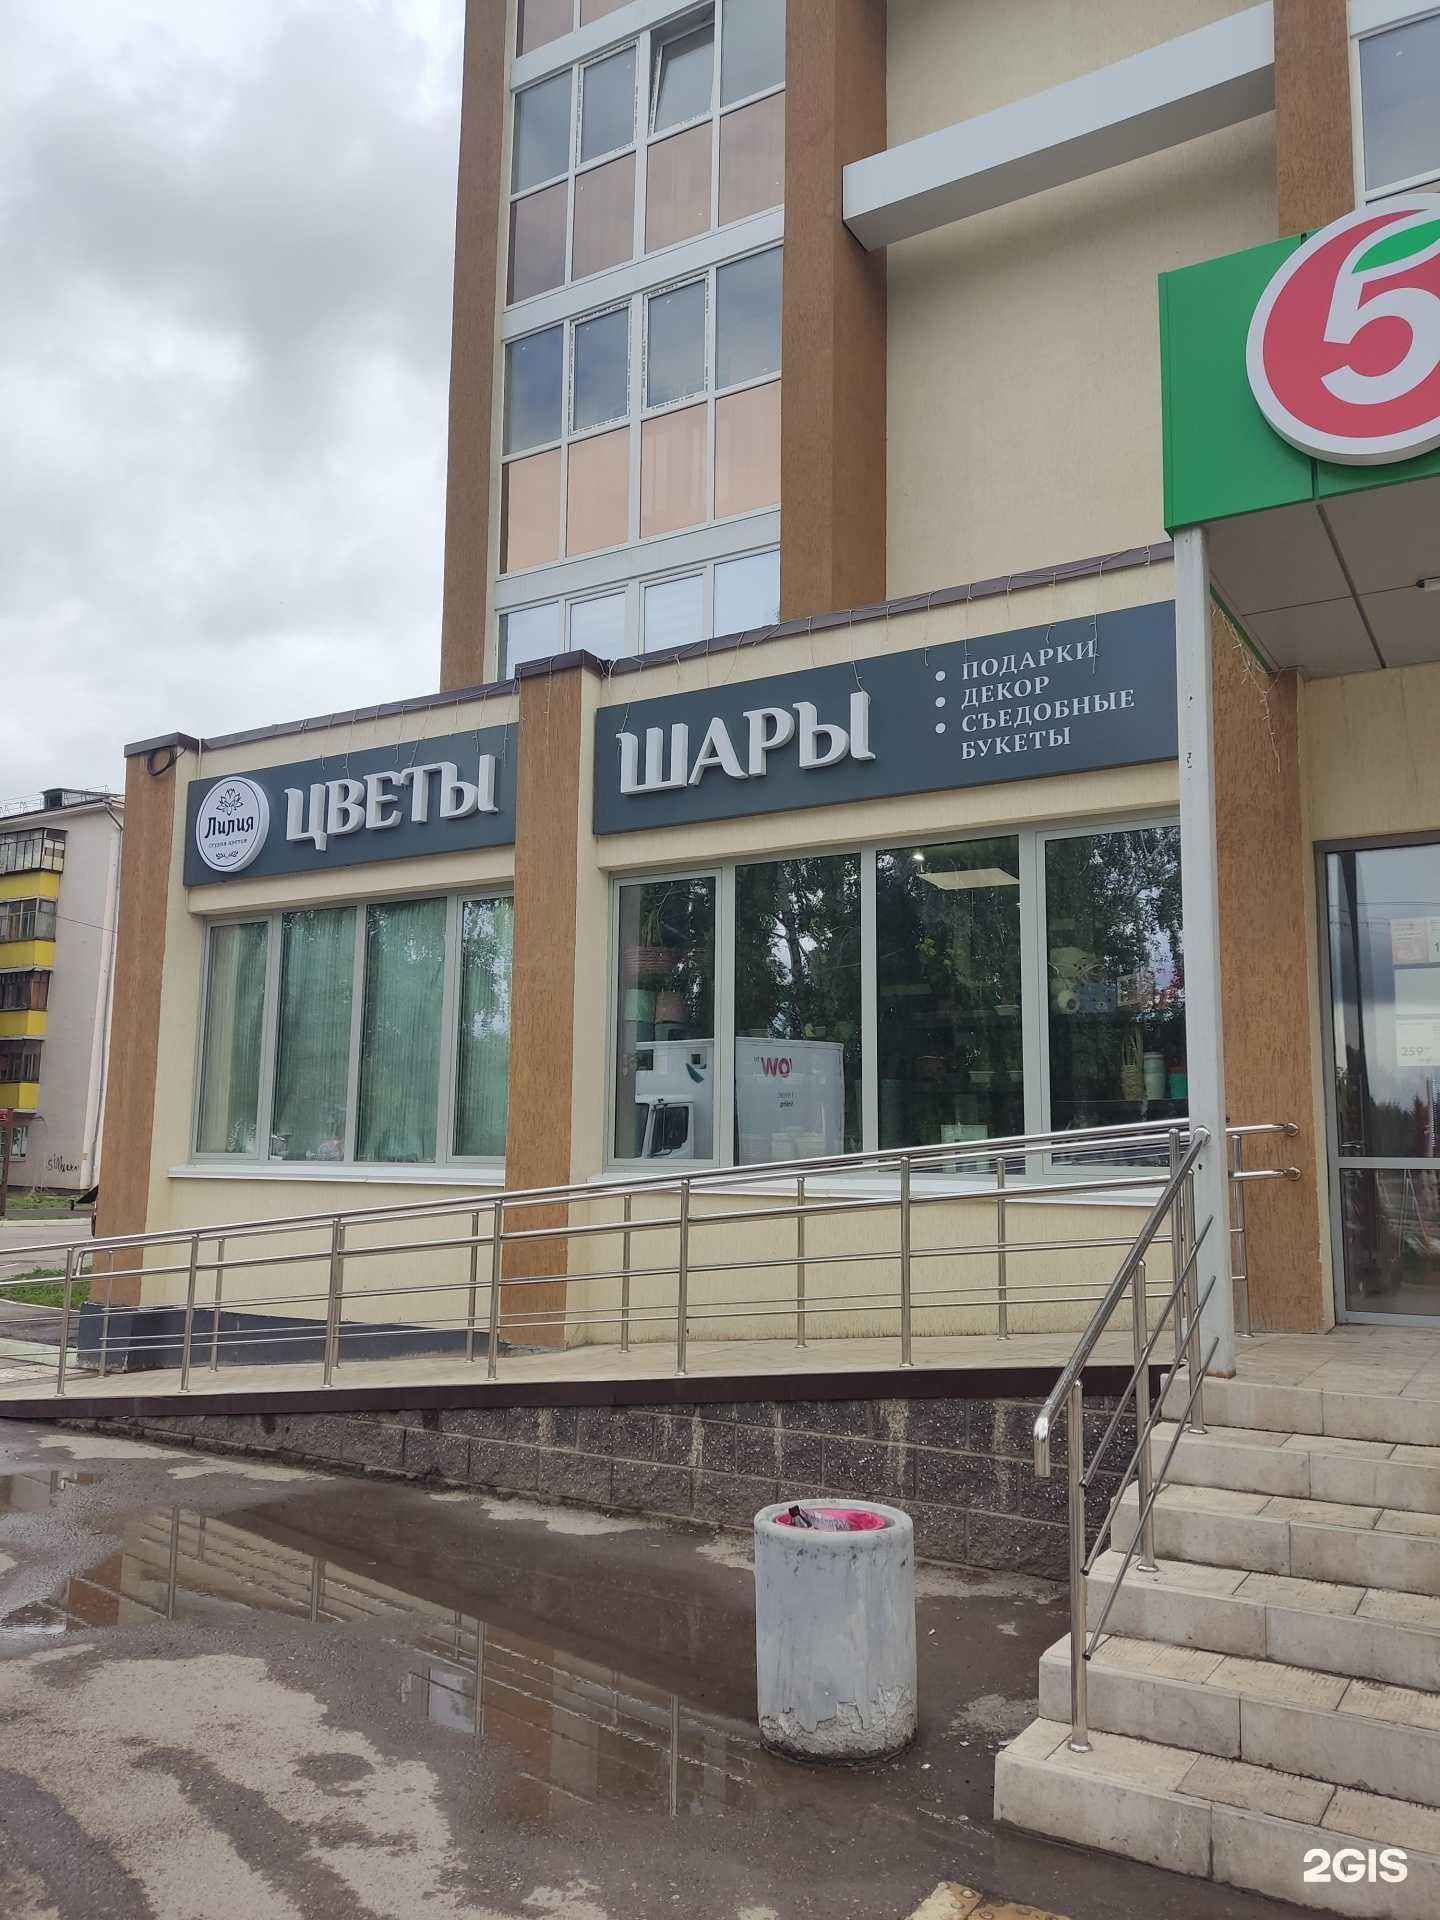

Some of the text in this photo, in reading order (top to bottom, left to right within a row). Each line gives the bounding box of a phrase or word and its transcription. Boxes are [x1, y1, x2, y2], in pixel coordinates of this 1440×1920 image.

[1321, 209, 1440, 405] 5
[961, 639, 1096, 680] ПОДАРКИ
[961, 676, 1050, 710] ДЕКОР
[961, 689, 1135, 732] СЪЕДОБНЫЕ
[616, 690, 876, 795] ШАРЫ
[961, 727, 1071, 760] БУКЕТЫ
[284, 753, 498, 851] ЦВЕТЫ
[204, 816, 254, 839] Лилия
